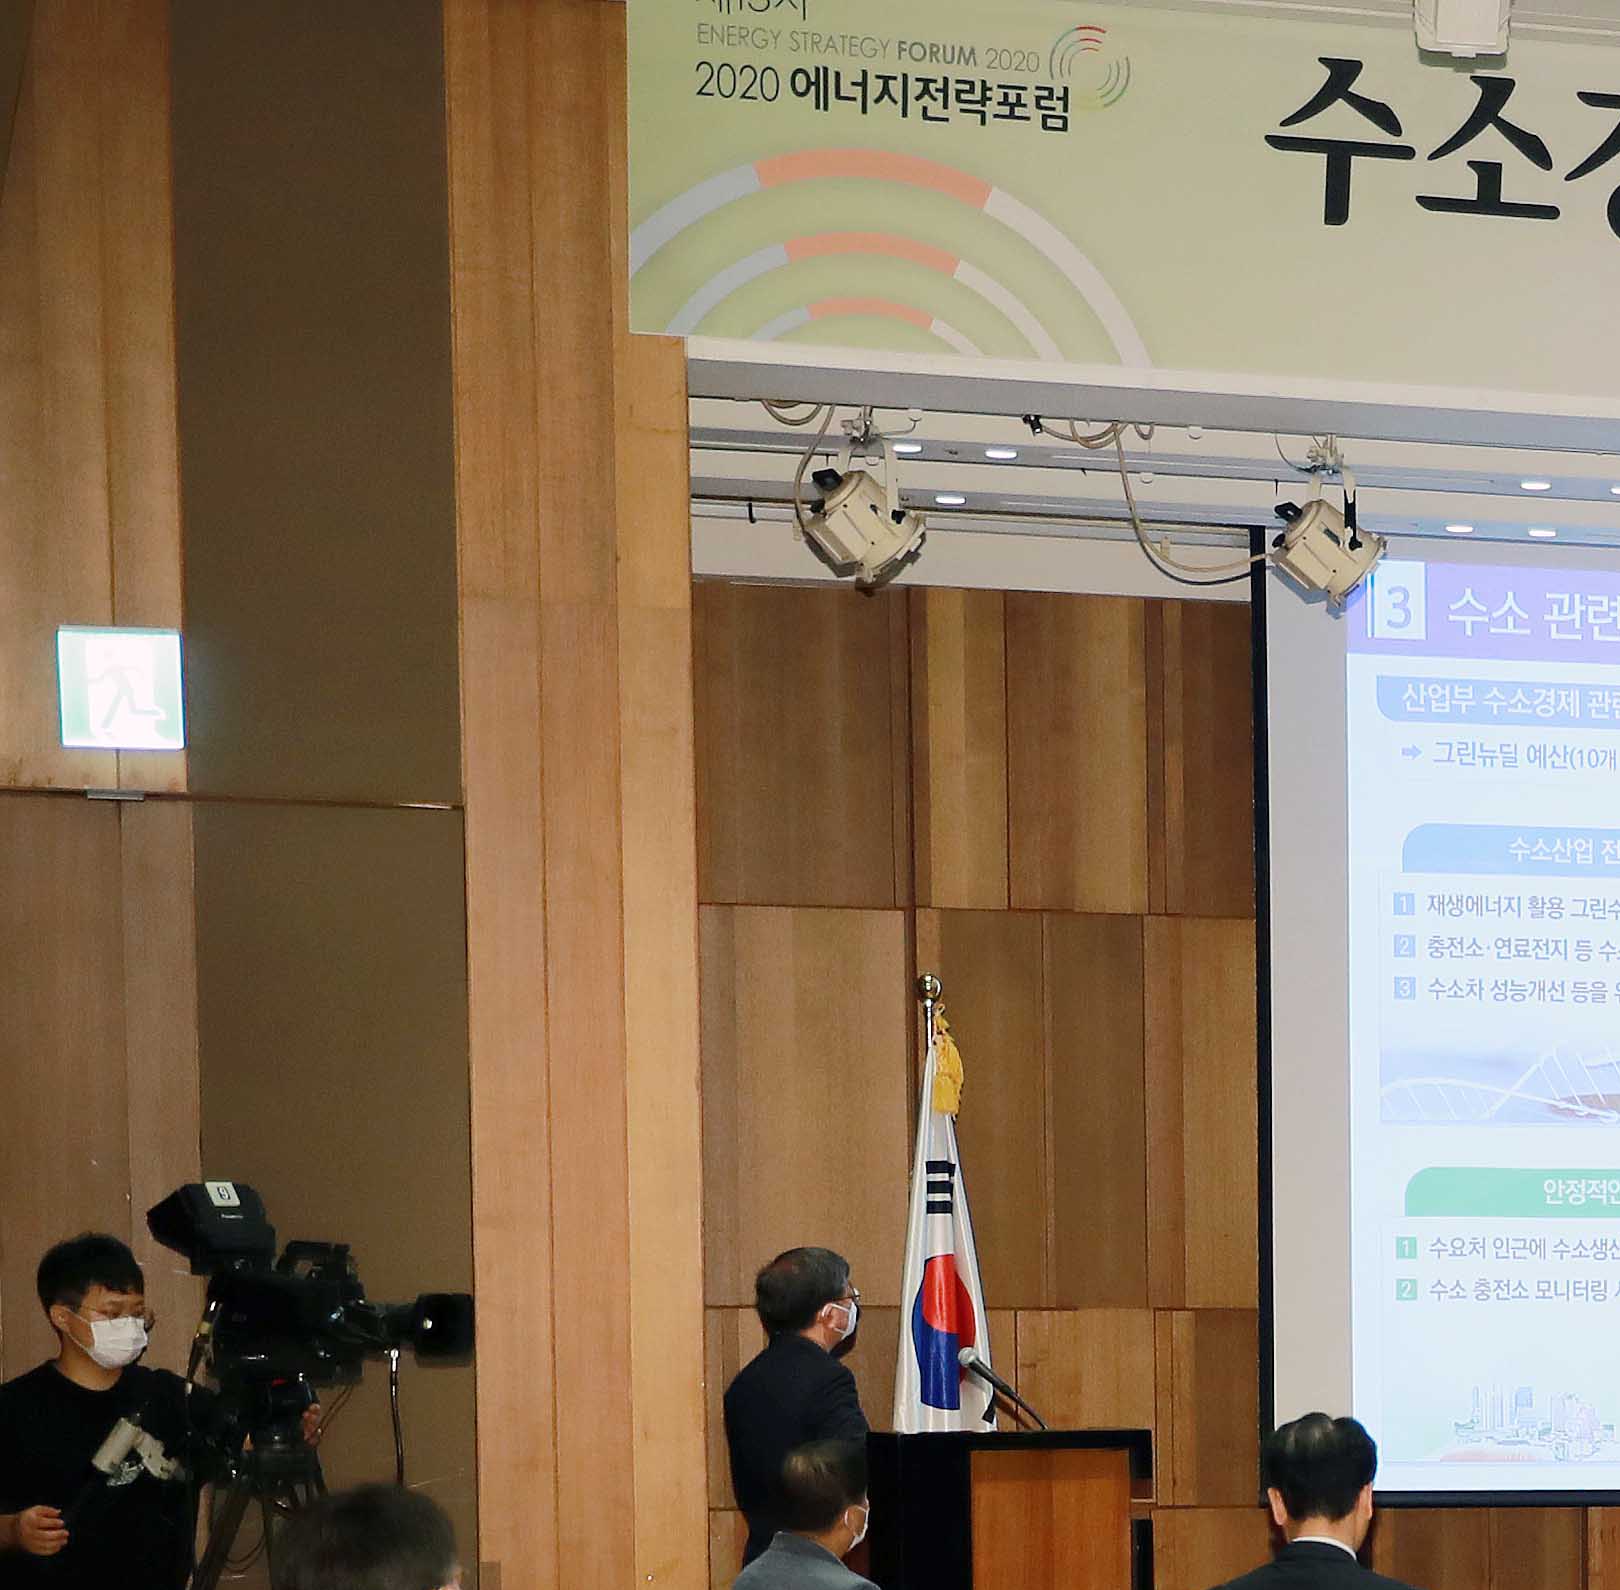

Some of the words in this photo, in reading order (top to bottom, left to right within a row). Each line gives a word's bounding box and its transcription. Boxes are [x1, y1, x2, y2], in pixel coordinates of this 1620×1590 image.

[697, 23, 782, 50] ENERGY
[789, 30, 890, 60] STRATEGY
[898, 41, 977, 67] FORUM
[985, 49, 1040, 73] 2020
[695, 61, 780, 102] 2020
[790, 66, 1070, 132] 에너지전략포럼
[1385, 584, 1411, 630] 3
[1447, 586, 1531, 638] 수소
[1402, 683, 1476, 714] 산업부
[1483, 687, 1580, 718] 수소경제
[1433, 741, 1519, 769] 그린뉴딜
[1526, 743, 1617, 771] 예산(10개
[1508, 836, 1594, 865] 수소산업
[1427, 894, 1522, 918] 재생에너지
[1527, 896, 1566, 920] 활용
[1574, 939, 1593, 962] 등
[1428, 977, 1484, 1001] 수소차
[1490, 979, 1566, 1003] 성능개선
[1570, 981, 1609, 1003] 등을
[1429, 1237, 1486, 1259] 수요처
[1493, 1238, 1546, 1260] 인근에
[1429, 1279, 1467, 1301] 수소
[1473, 1278, 1530, 1301] 충전소
[1535, 1279, 1608, 1302] 모니터링
